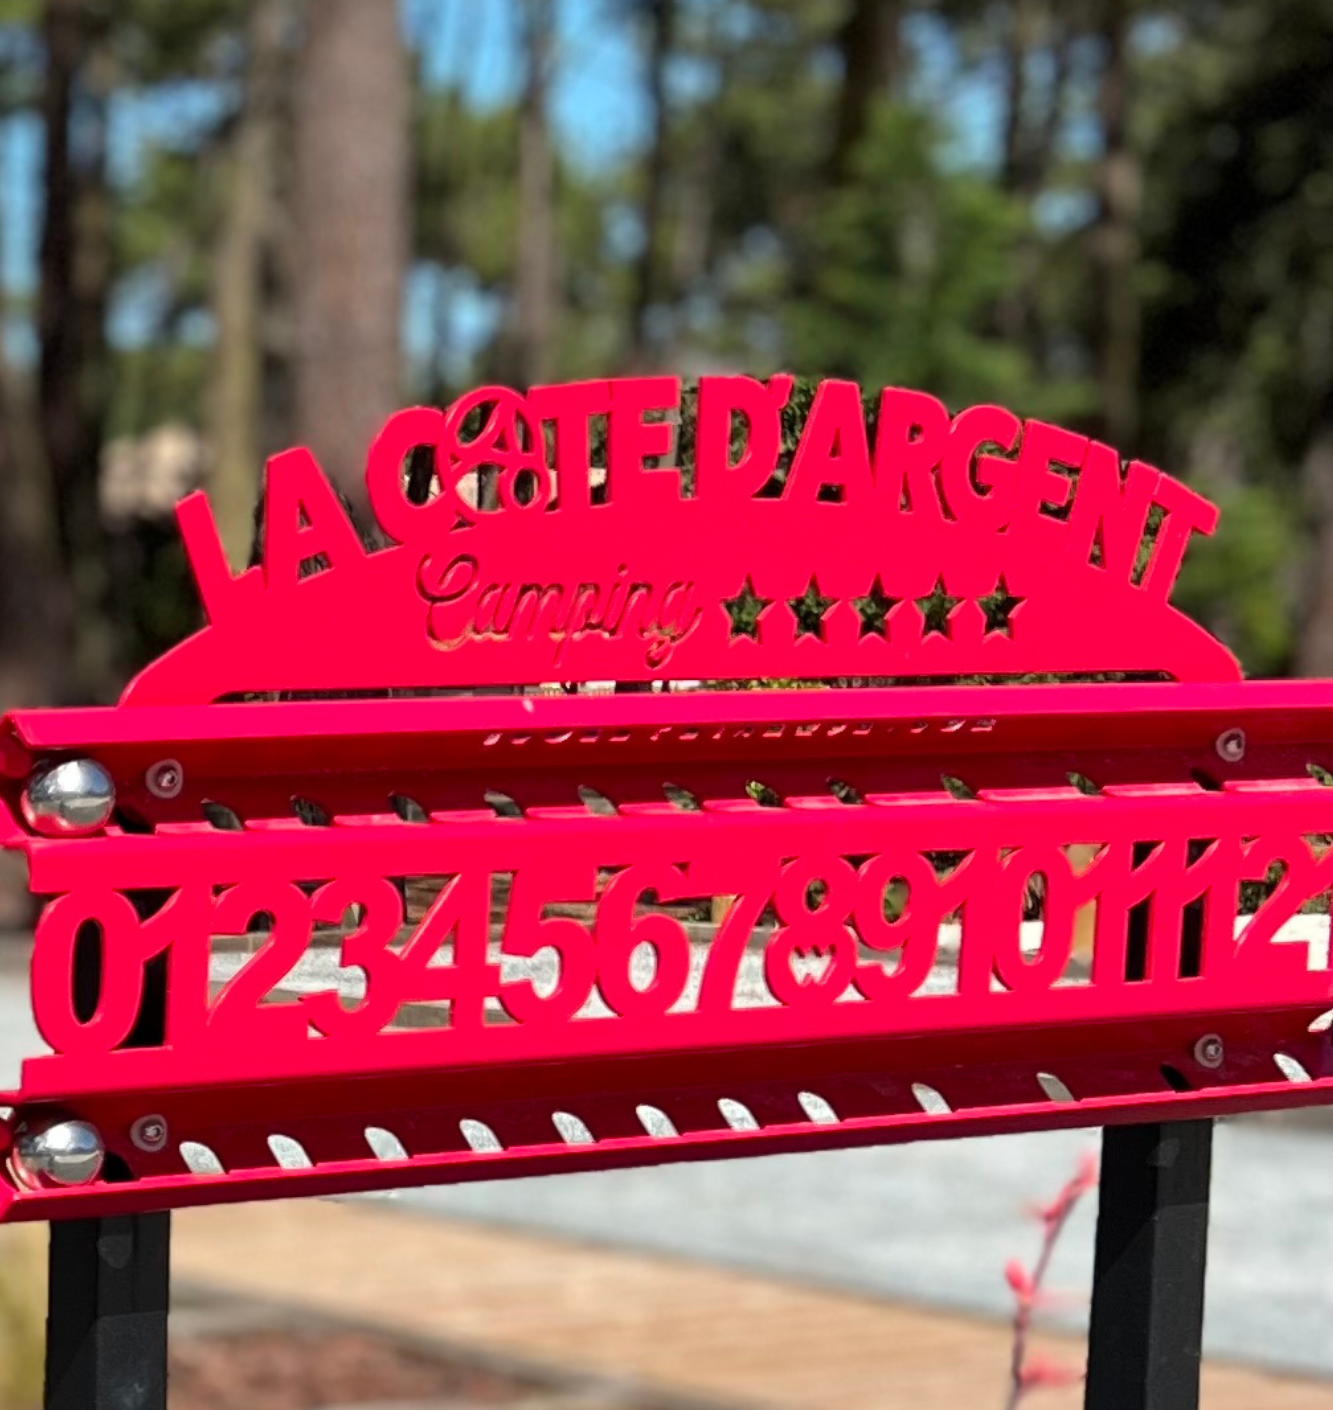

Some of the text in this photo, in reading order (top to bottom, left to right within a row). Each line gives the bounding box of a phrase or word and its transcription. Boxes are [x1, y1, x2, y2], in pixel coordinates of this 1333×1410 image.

[175, 446, 375, 628] LA
[695, 373, 1221, 603] D'ARGENT
[415, 553, 702, 669] Camping
